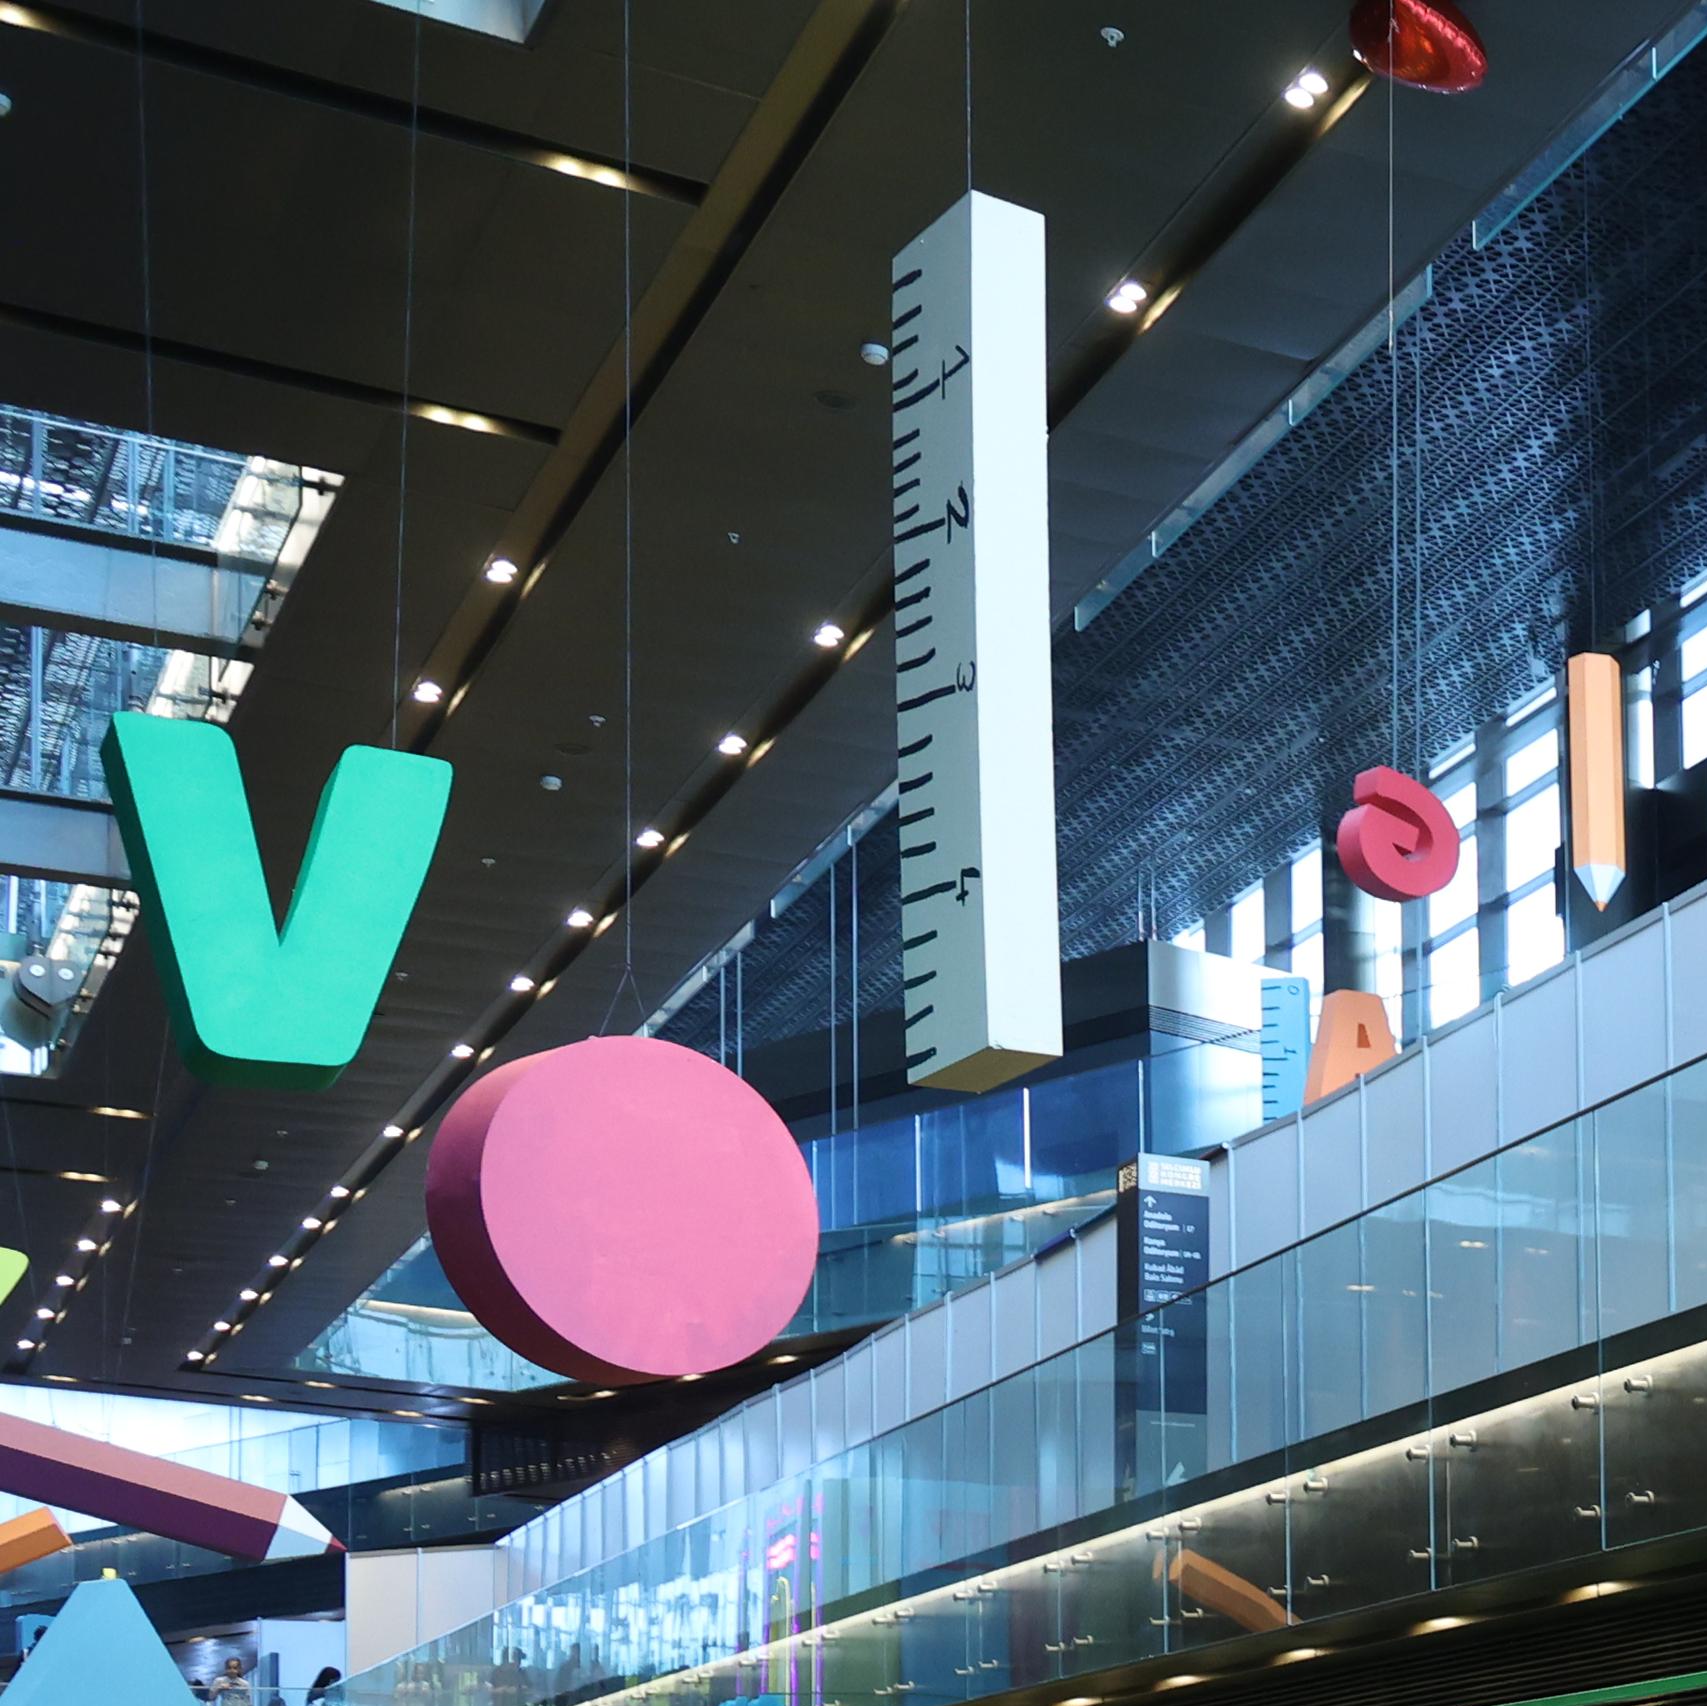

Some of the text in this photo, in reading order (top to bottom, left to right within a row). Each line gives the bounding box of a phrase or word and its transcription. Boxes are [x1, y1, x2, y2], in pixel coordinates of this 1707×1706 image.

[946, 480, 969, 544] 2
[956, 660, 976, 692] 3
[103, 710, 453, 1086] V
[955, 866, 981, 907] 4
